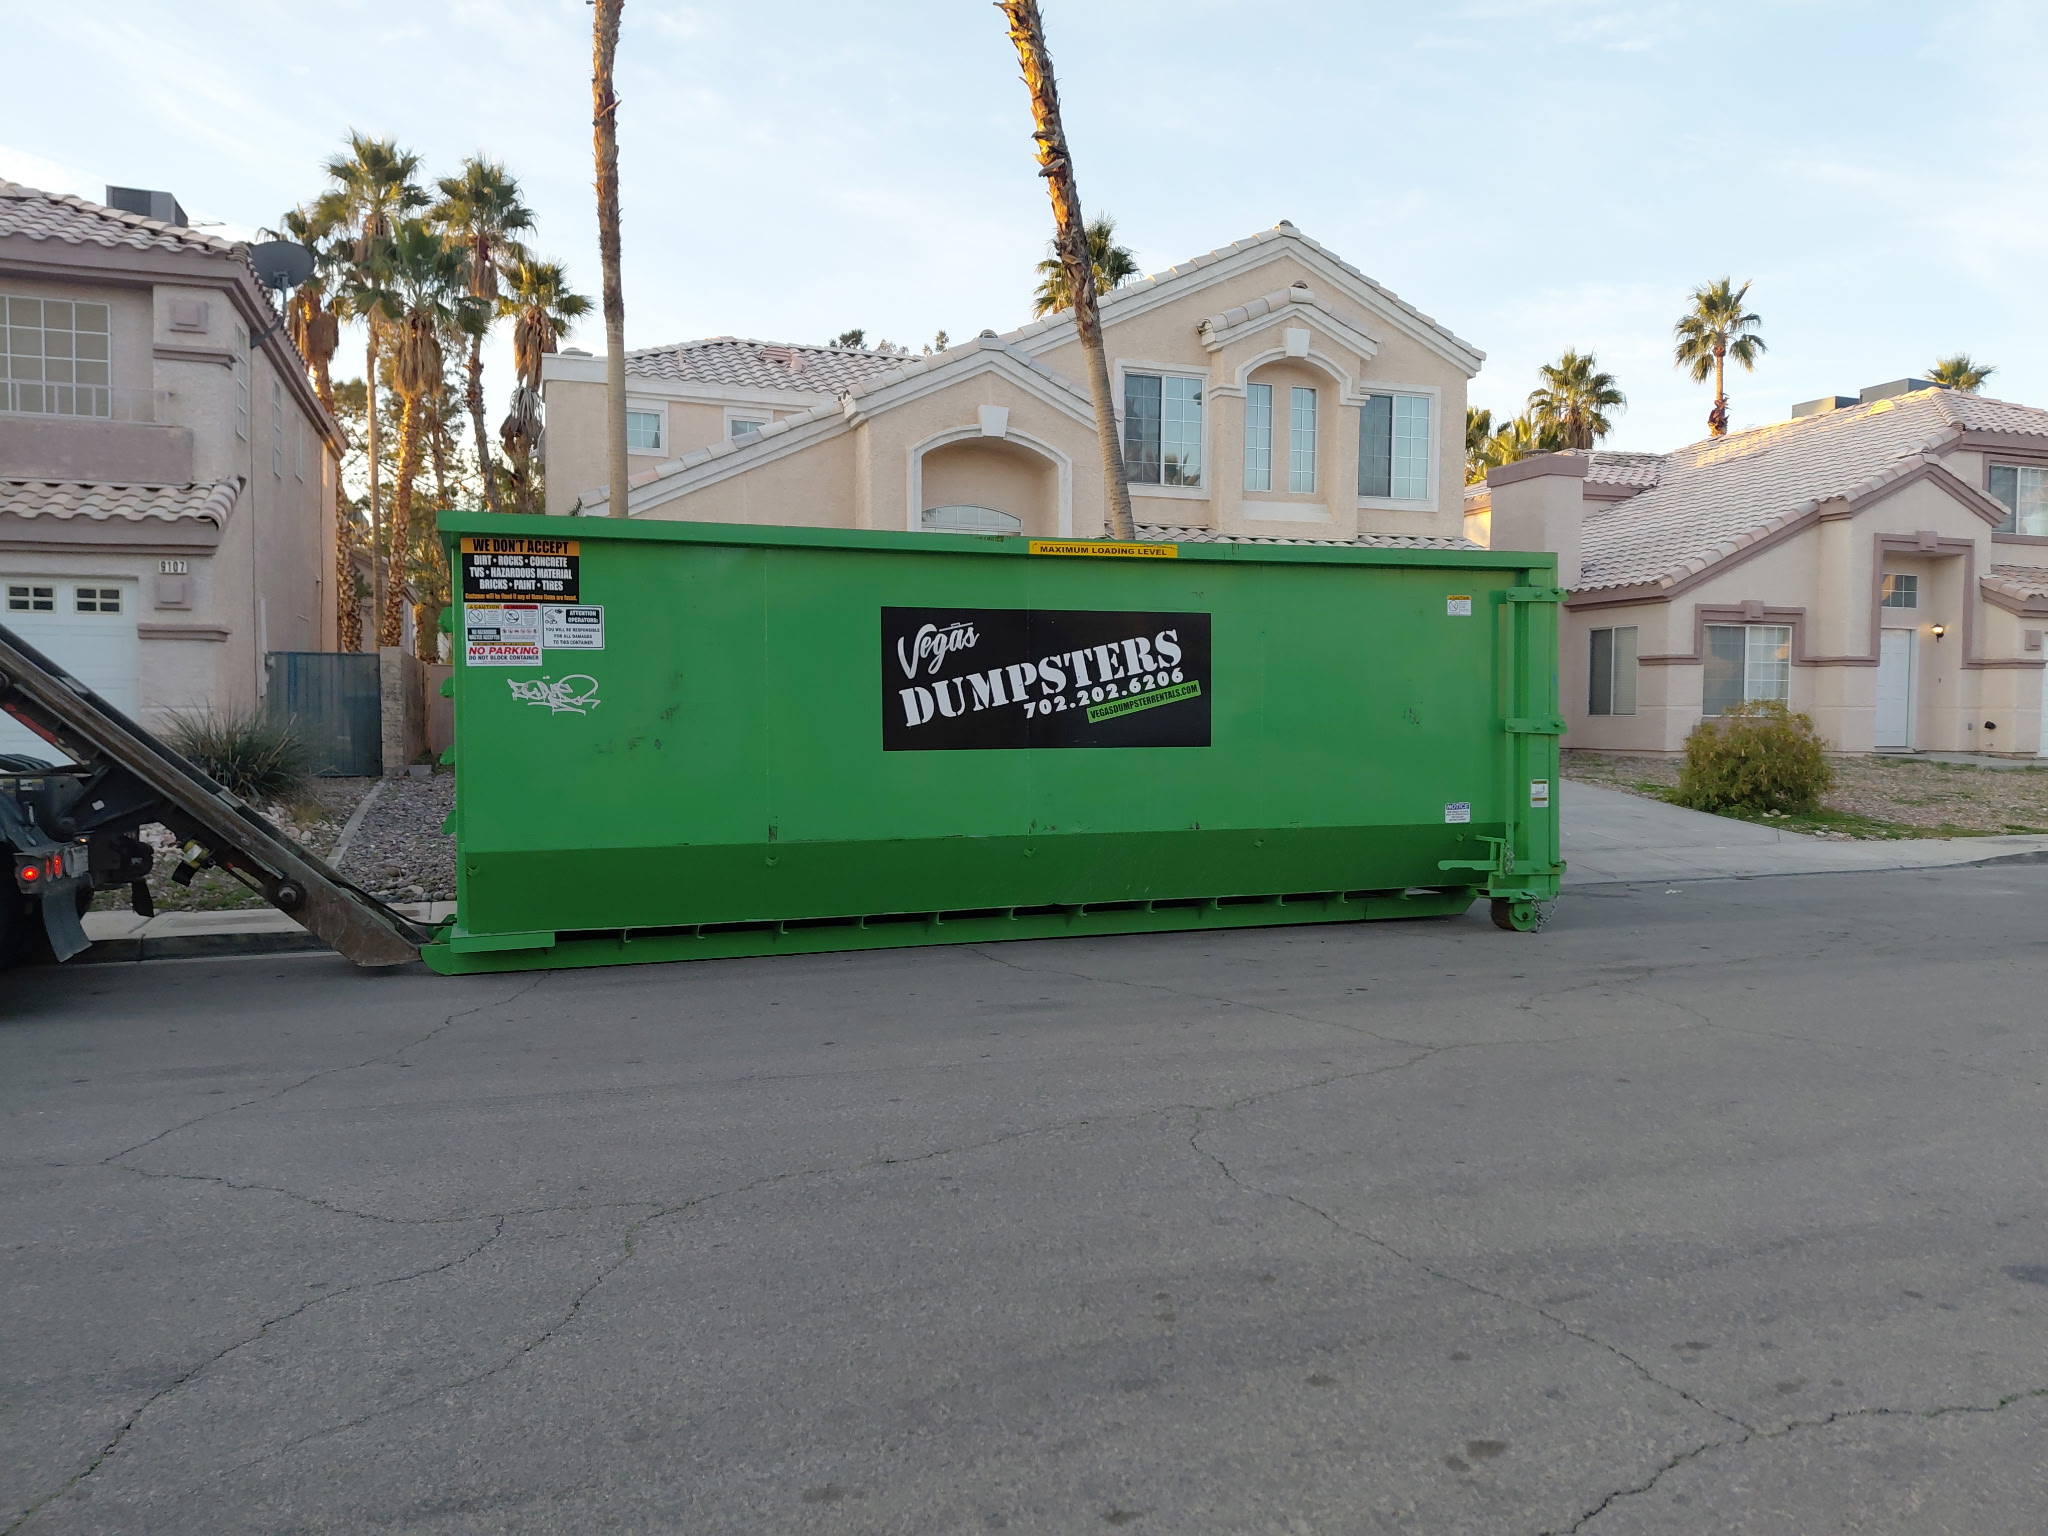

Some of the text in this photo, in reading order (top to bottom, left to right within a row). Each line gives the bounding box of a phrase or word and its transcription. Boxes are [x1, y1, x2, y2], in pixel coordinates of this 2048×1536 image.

[473, 539, 569, 554] WE DON'T ACCEPT
[1040, 546, 1167, 556] MAXIMUM LOADING LEVEL
[161, 561, 184, 572] 9107
[474, 555, 567, 567] DIRT ROCKS CONCRETE
[469, 567, 572, 579] TVS HAZARDOUS MATERIAL
[480, 579, 563, 591] BRICKS PAINT TIRES
[897, 622, 980, 680] Vegas
[898, 629, 1183, 727] DUMPSTERS
[1024, 668, 1184, 719] 702.202.6206
[1090, 683, 1198, 720] VEGASDUMPSTERRENTALS.COM
